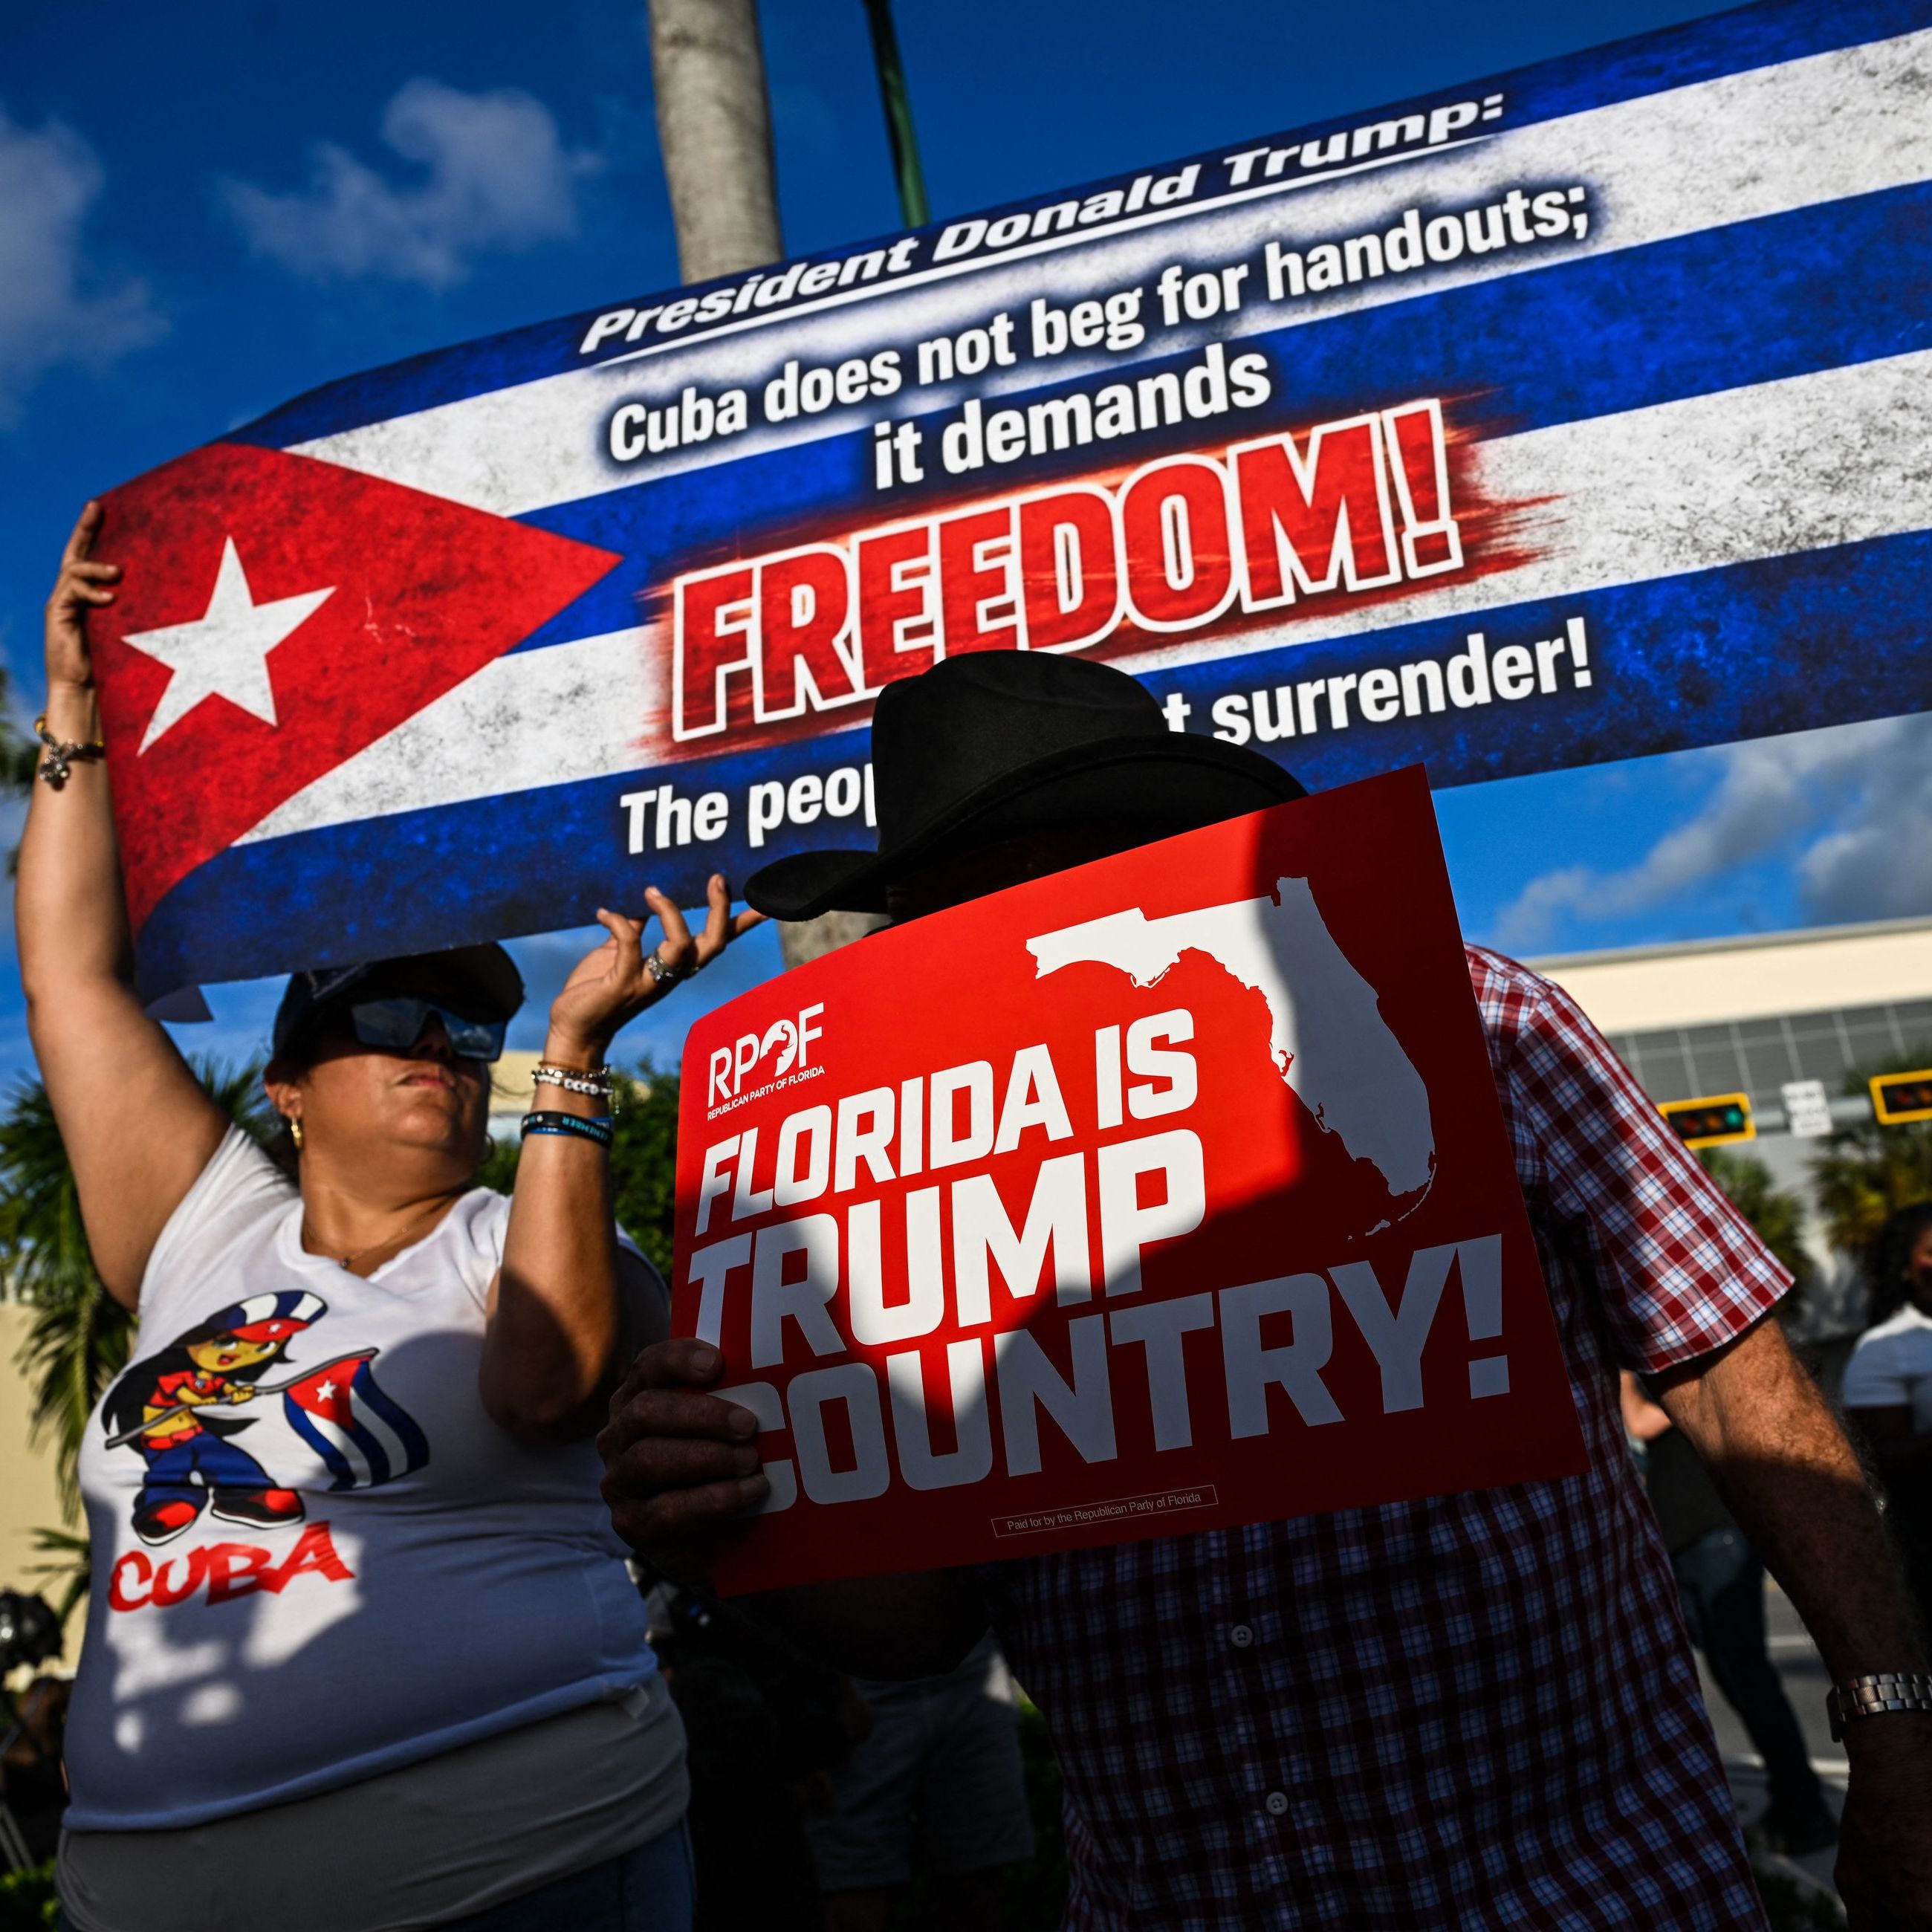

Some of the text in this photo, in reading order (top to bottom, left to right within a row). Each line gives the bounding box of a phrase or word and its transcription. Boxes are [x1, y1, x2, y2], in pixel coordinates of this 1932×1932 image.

[580, 94, 1503, 354] President Donald Trump:
[609, 186, 1589, 461] Cuba does not beg for handouts;
[875, 343, 1271, 490] it demands
[672, 398, 1464, 742] FREEDOM!
[620, 785, 728, 854] The
[748, 763, 877, 848] peo
[1212, 617, 1592, 746] surrender!
[695, 1008, 1198, 1237] FLORIDA IS
[707, 1065, 826, 1121] REPUBLICAN PARTY OF FLORIDA
[687, 1129, 1206, 1369] TRUMP
[109, 1520, 356, 1612] CUBA
[1007, 1492, 1202, 1531] Paid for by the Republican Party of Florida
